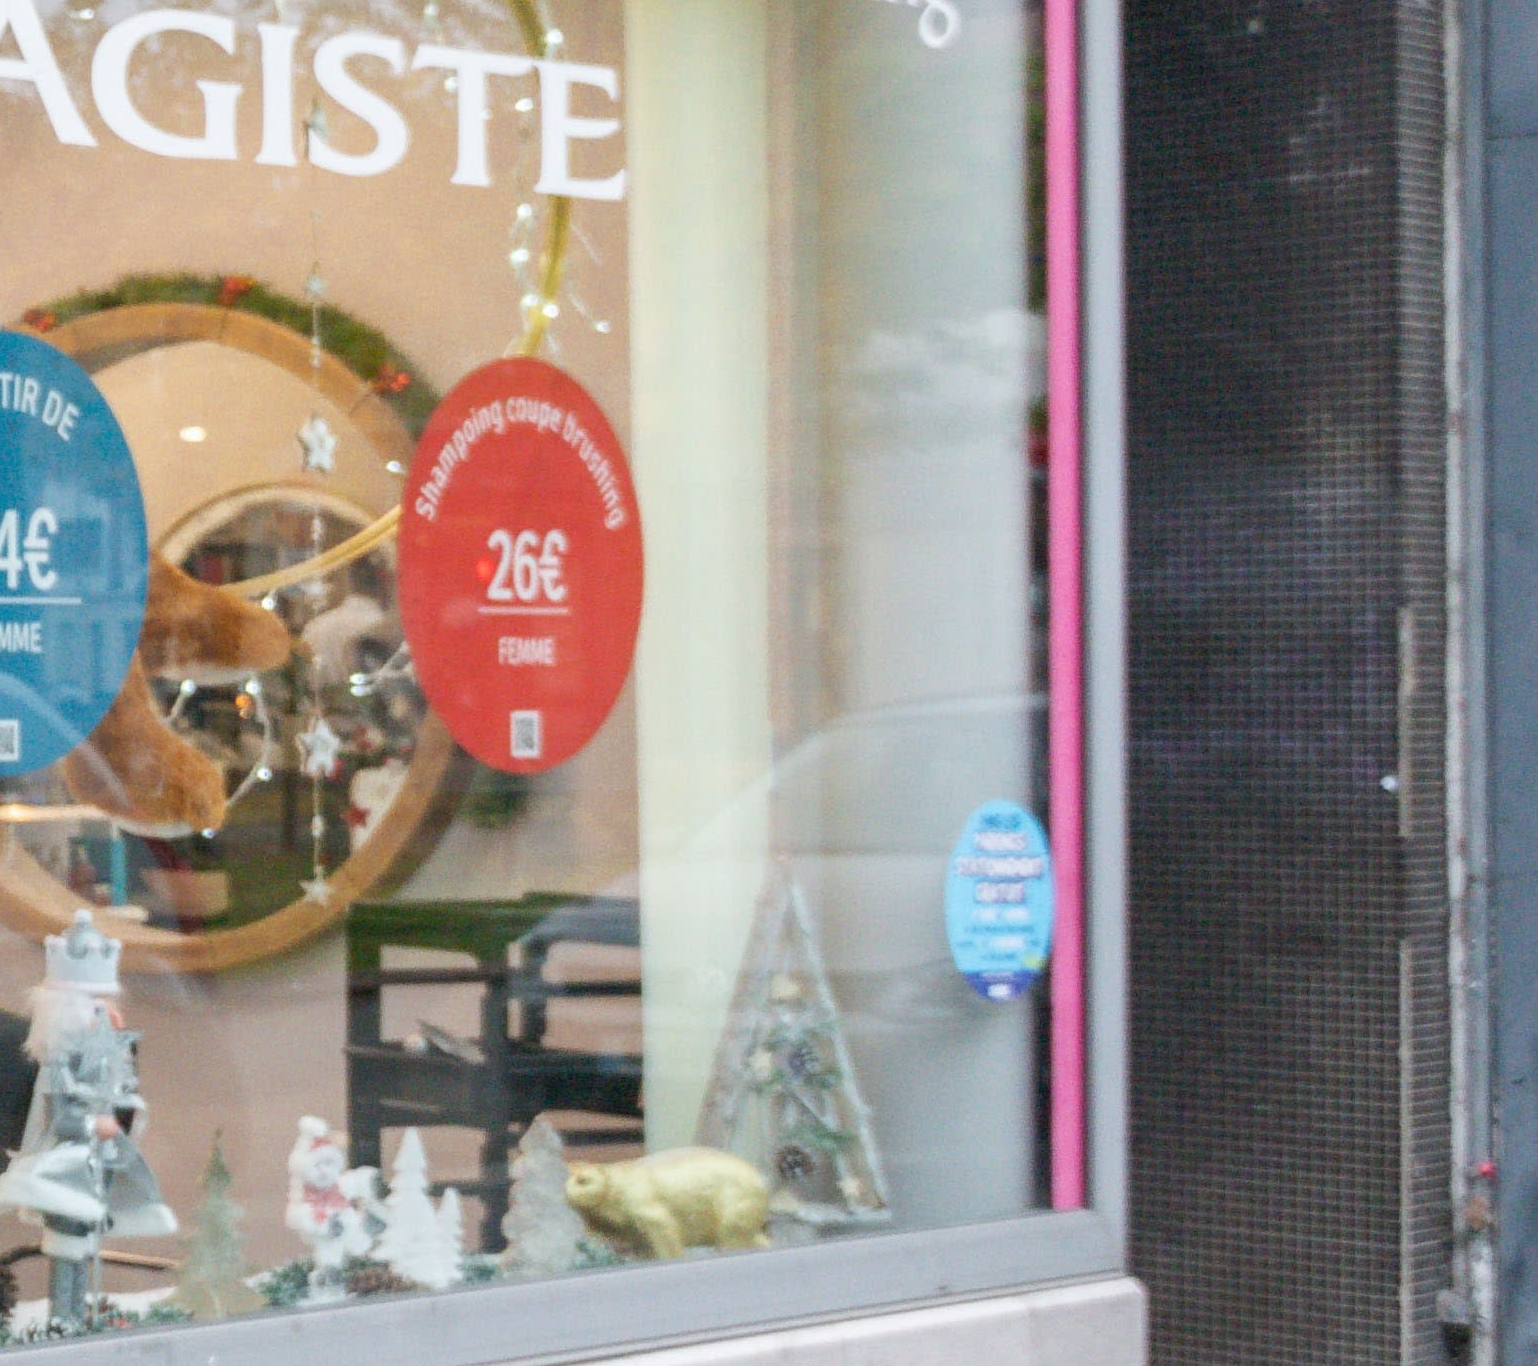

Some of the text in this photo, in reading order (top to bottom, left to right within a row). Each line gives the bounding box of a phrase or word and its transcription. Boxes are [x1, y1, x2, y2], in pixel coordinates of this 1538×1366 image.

[40, 390, 82, 441] DE
[415, 396, 628, 531] Shampoing coupe brushing
[487, 528, 567, 602] 26€
[499, 636, 556, 665] FEMME
